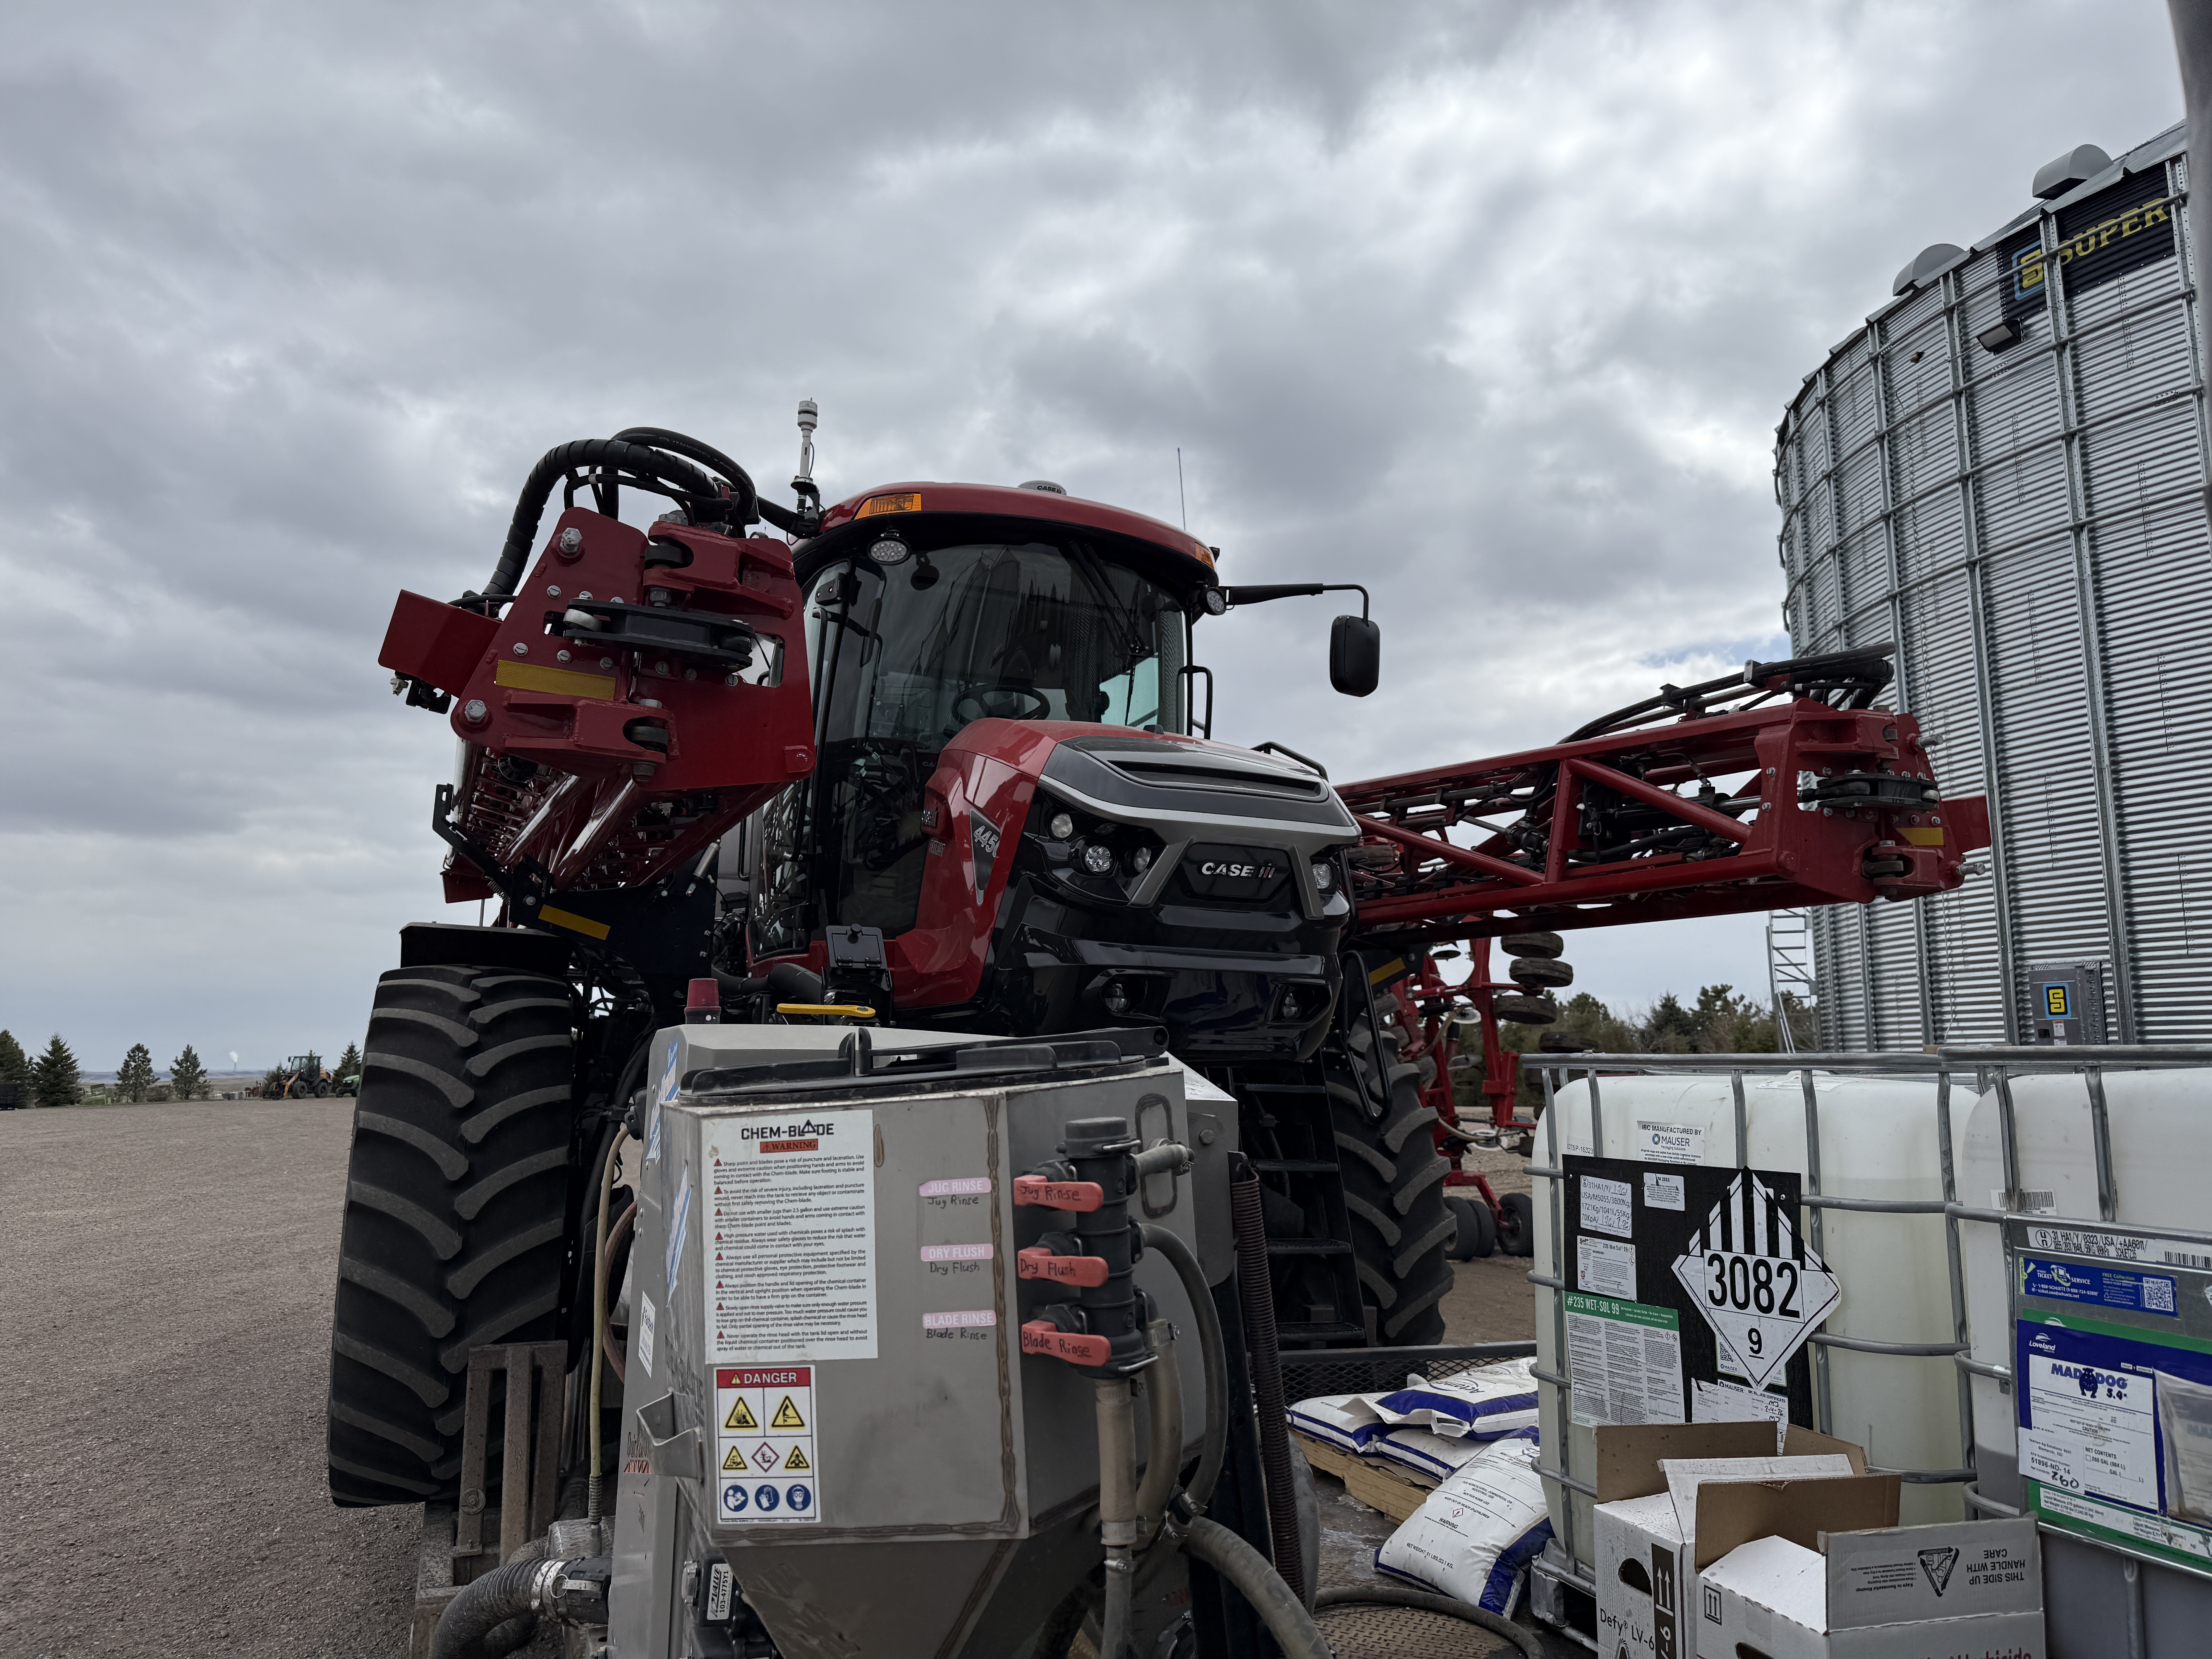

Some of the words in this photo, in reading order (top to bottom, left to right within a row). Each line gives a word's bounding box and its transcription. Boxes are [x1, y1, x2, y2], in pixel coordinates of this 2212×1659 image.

[1201, 862, 1255, 877] CASE
[741, 1119, 834, 1140] CHEM-BLADE
[1652, 1125, 1693, 1135] MANUFACTURED
[771, 1141, 816, 1151] WARNING
[1661, 1135, 1690, 1146] MAUSER
[929, 1182, 948, 1193] JUG
[952, 1180, 983, 1192] RINSE
[1020, 1186, 1039, 1200] Jug
[927, 1197, 946, 1209] Jug
[951, 1195, 979, 1205] Rinse
[929, 1248, 950, 1259] DRY
[953, 1246, 984, 1257] FLUSH
[930, 1262, 948, 1275] Dry
[953, 1261, 980, 1274] Flush
[1020, 1258, 1038, 1274] Dry
[1048, 1262, 1076, 1277] Flush
[1707, 1252, 1800, 1321] 3082
[1567, 1296, 1584, 1308] #235
[1585, 1298, 1610, 1313] WET-SOL
[1612, 1304, 1619, 1314] 99
[925, 1315, 959, 1326] BLADE
[962, 1313, 993, 1325] RINSE
[926, 1329, 954, 1339] Blade
[961, 1329, 987, 1340] Rinse
[1024, 1332, 1052, 1350] Blade
[1748, 1328, 1762, 1355] 9
[2029, 1340, 2056, 1351] Loveland
[744, 1372, 797, 1384] DANGER
[2051, 1363, 2083, 1379] MAD
[2095, 1372, 2128, 1389] DOG
[1724, 1383, 1744, 1393] MAUSER
[2094, 1449, 2117, 1459] CONTENTS
[2051, 1470, 2079, 1489] 260
[1983, 1549, 2008, 1559] CARE
[1966, 1562, 1987, 1573] WITH
[1990, 1559, 2025, 1571] HANDLE
[1969, 1575, 1980, 1585] UP
[1983, 1573, 2002, 1584] SIDE
[2006, 1571, 2025, 1582] THIS
[720, 1570, 729, 1613] 103-4775Y1
[1632, 1625, 1655, 1650] LV-6
